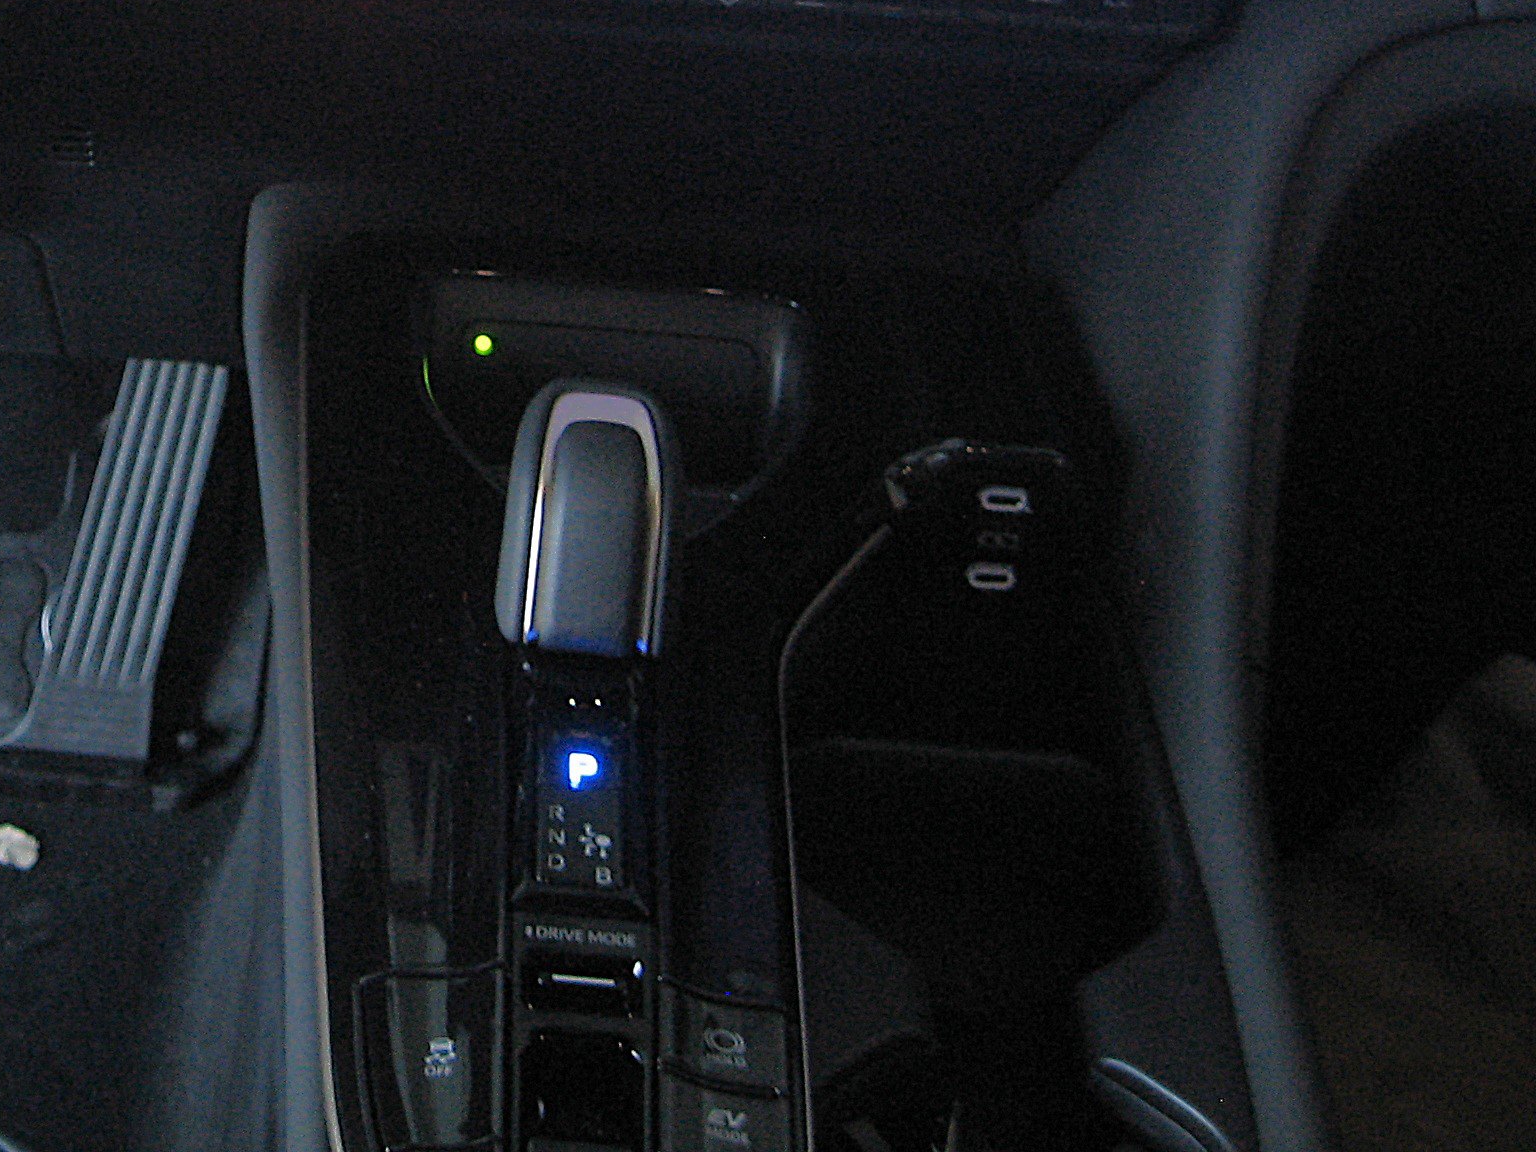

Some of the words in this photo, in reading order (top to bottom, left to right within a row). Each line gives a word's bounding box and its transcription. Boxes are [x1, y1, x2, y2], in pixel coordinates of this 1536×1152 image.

[568, 751, 599, 790] P
[548, 804, 565, 821] R
[548, 827, 565, 846] N
[548, 853, 565, 872] D
[594, 865, 613, 885] B
[535, 925, 585, 945] DRIVE
[587, 929, 637, 949] MODE
